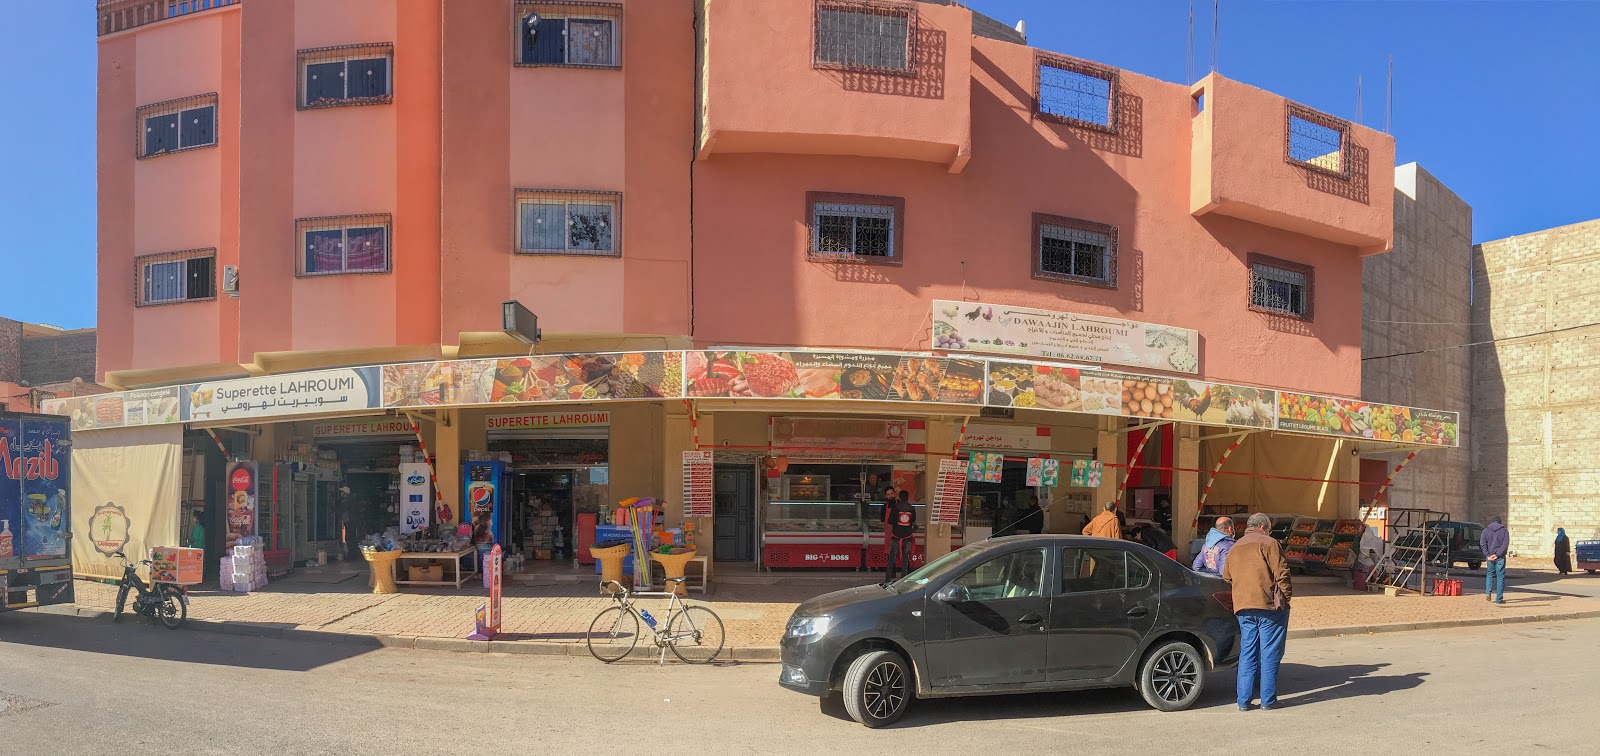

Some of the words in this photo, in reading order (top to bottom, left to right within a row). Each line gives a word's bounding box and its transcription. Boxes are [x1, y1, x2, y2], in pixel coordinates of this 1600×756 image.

[1014, 317, 1069, 330] DAWAAJIN
[1072, 323, 1128, 337] LAHROUMI
[130, 391, 150, 399] Poisson
[151, 389, 171, 398] congelé
[216, 385, 277, 402] Superette
[280, 377, 354, 395] LAHROUMI
[488, 415, 549, 428] SUPERETTE
[553, 413, 609, 425] LAHROUMI
[315, 424, 368, 436] SUPERETTE
